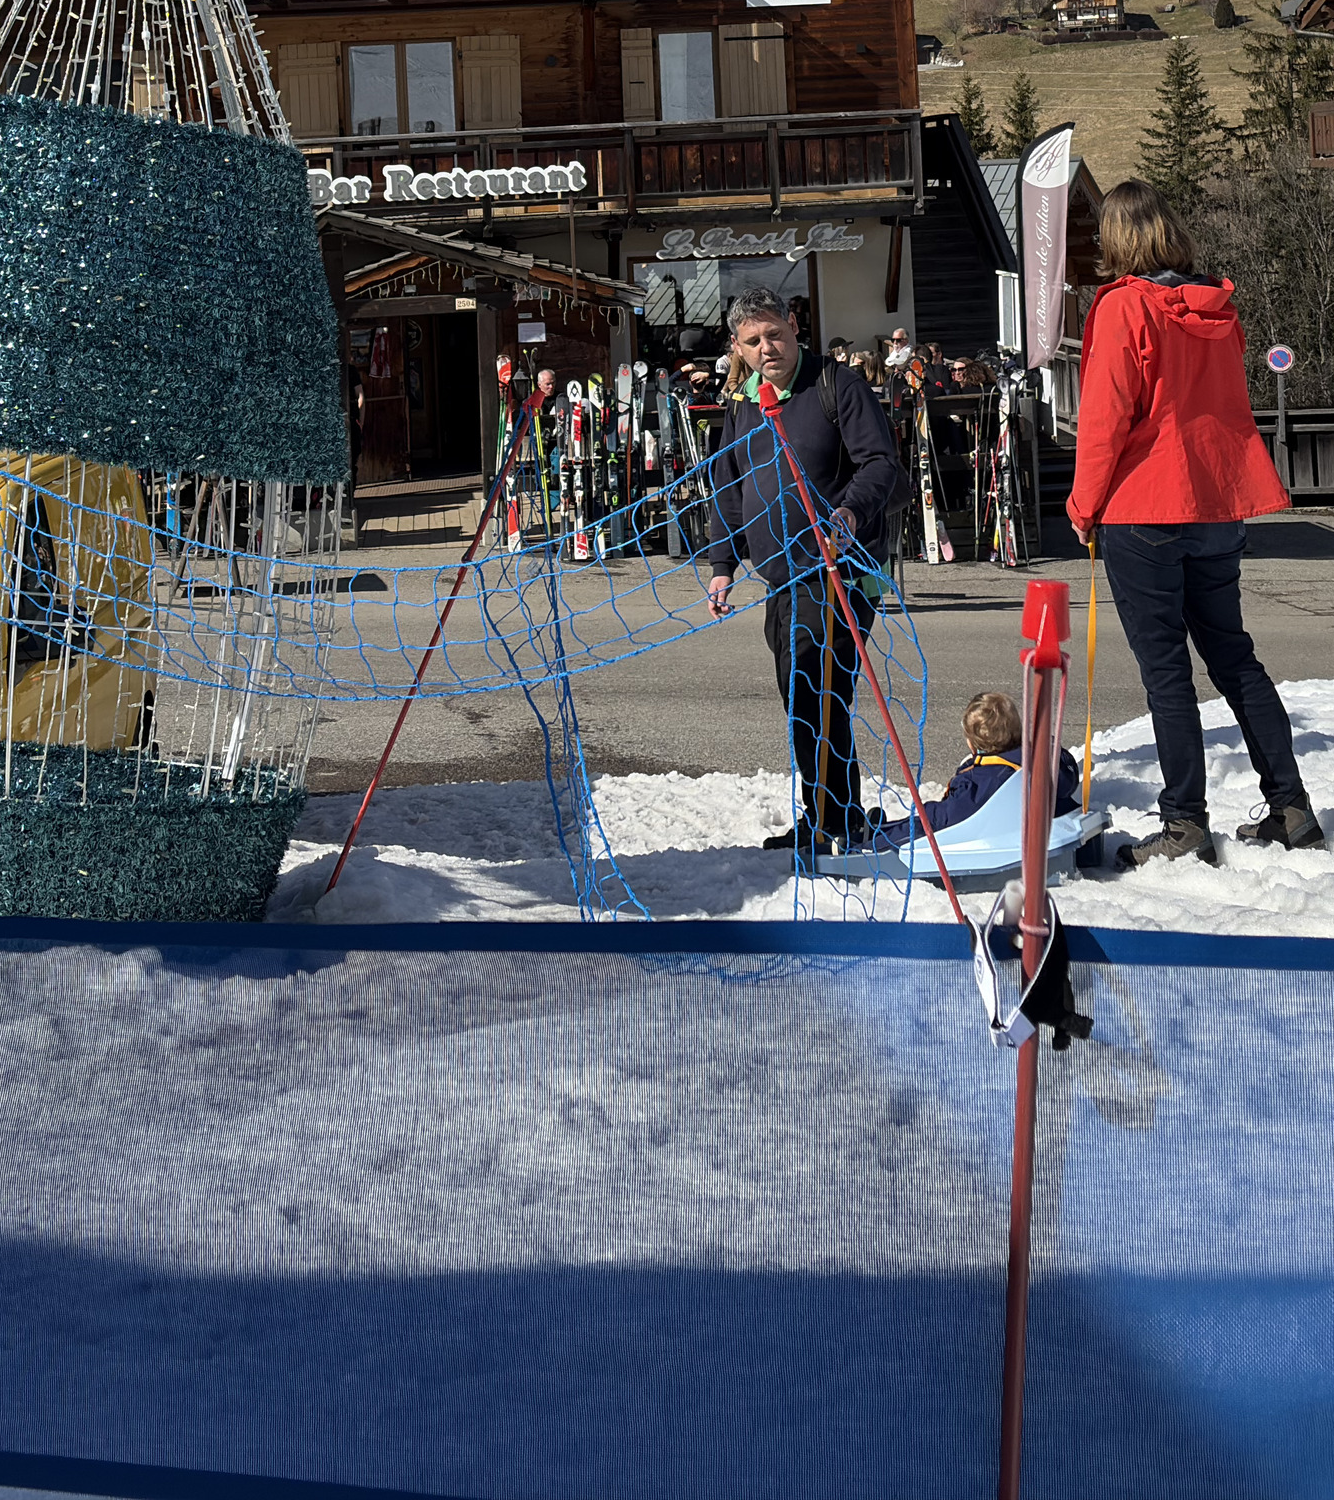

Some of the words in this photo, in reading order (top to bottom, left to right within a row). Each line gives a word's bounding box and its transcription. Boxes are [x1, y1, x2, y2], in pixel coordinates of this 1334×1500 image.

[308, 169, 372, 205] Bar
[383, 161, 586, 201] Restaurant
[1036, 194, 1053, 248] Julien
[1035, 246, 1048, 267] de
[457, 299, 475, 308] 2504
[1035, 269, 1048, 328] Bistrot
